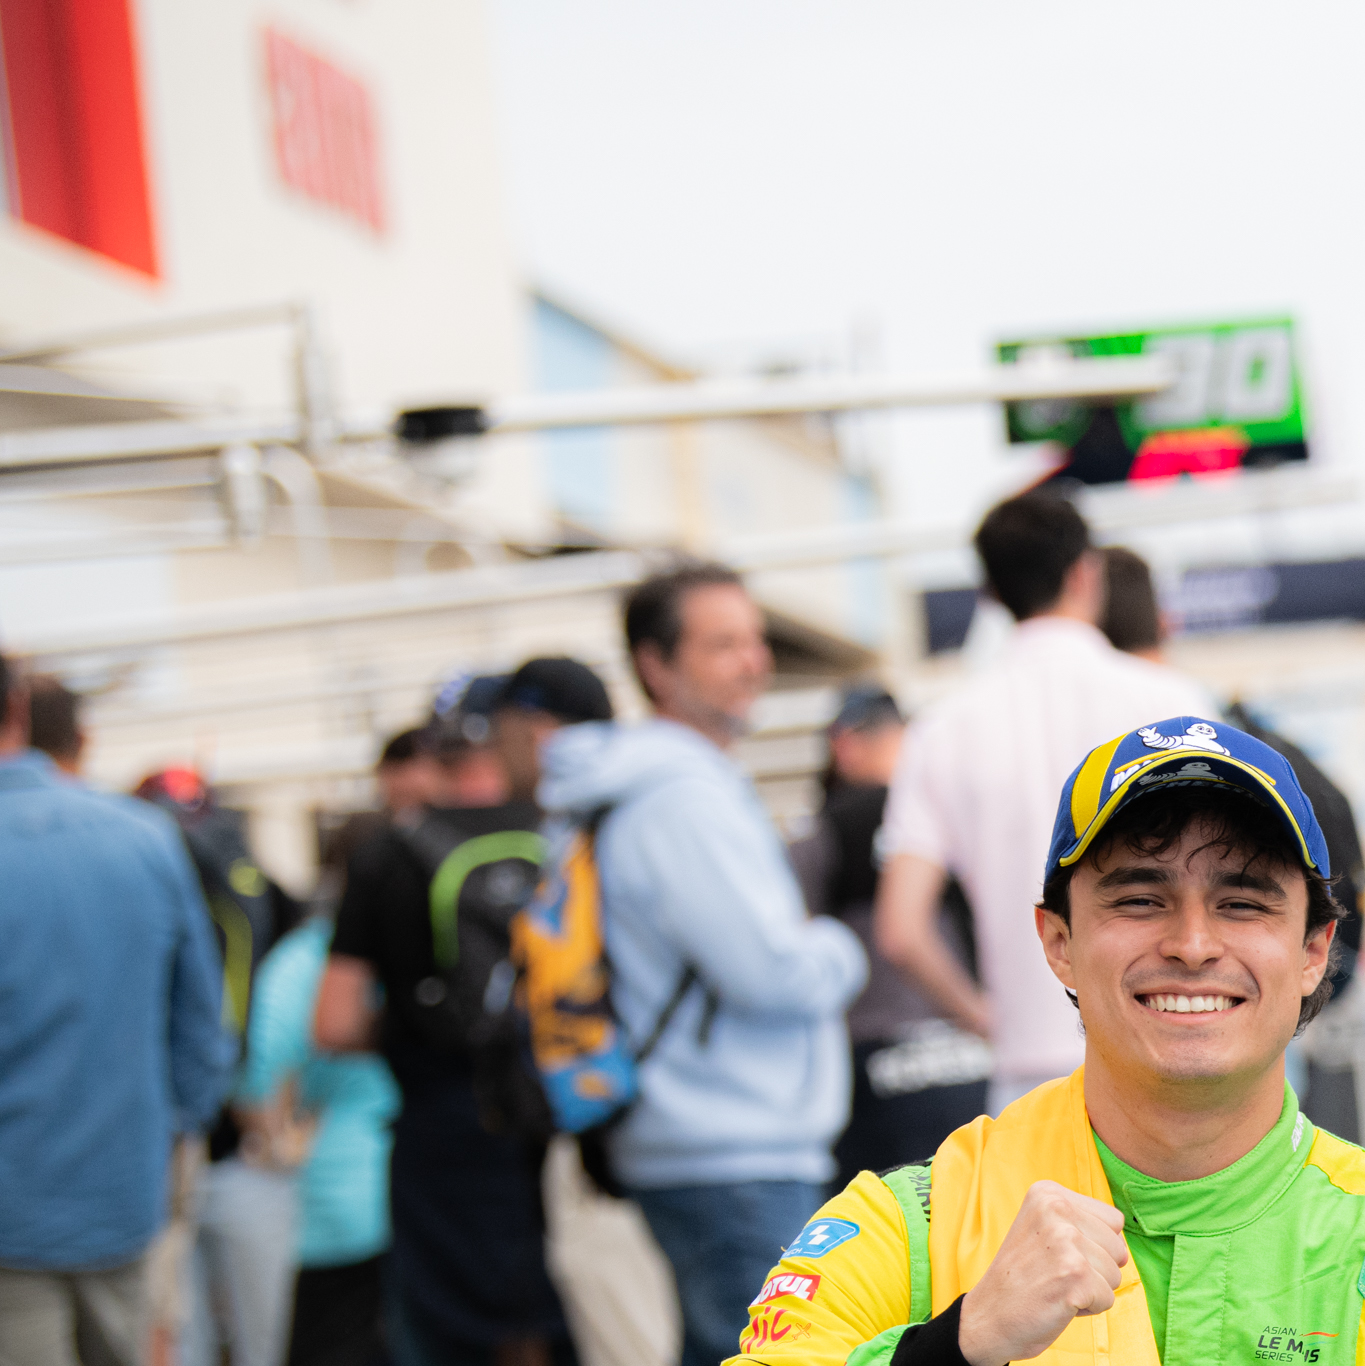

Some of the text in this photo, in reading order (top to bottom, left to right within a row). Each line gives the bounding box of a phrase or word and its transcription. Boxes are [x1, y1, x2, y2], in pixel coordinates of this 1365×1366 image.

[1263, 1326, 1297, 1336] ASIAN
[1258, 1335, 1282, 1349] LE
[1255, 1350, 1294, 1362] SERIES
